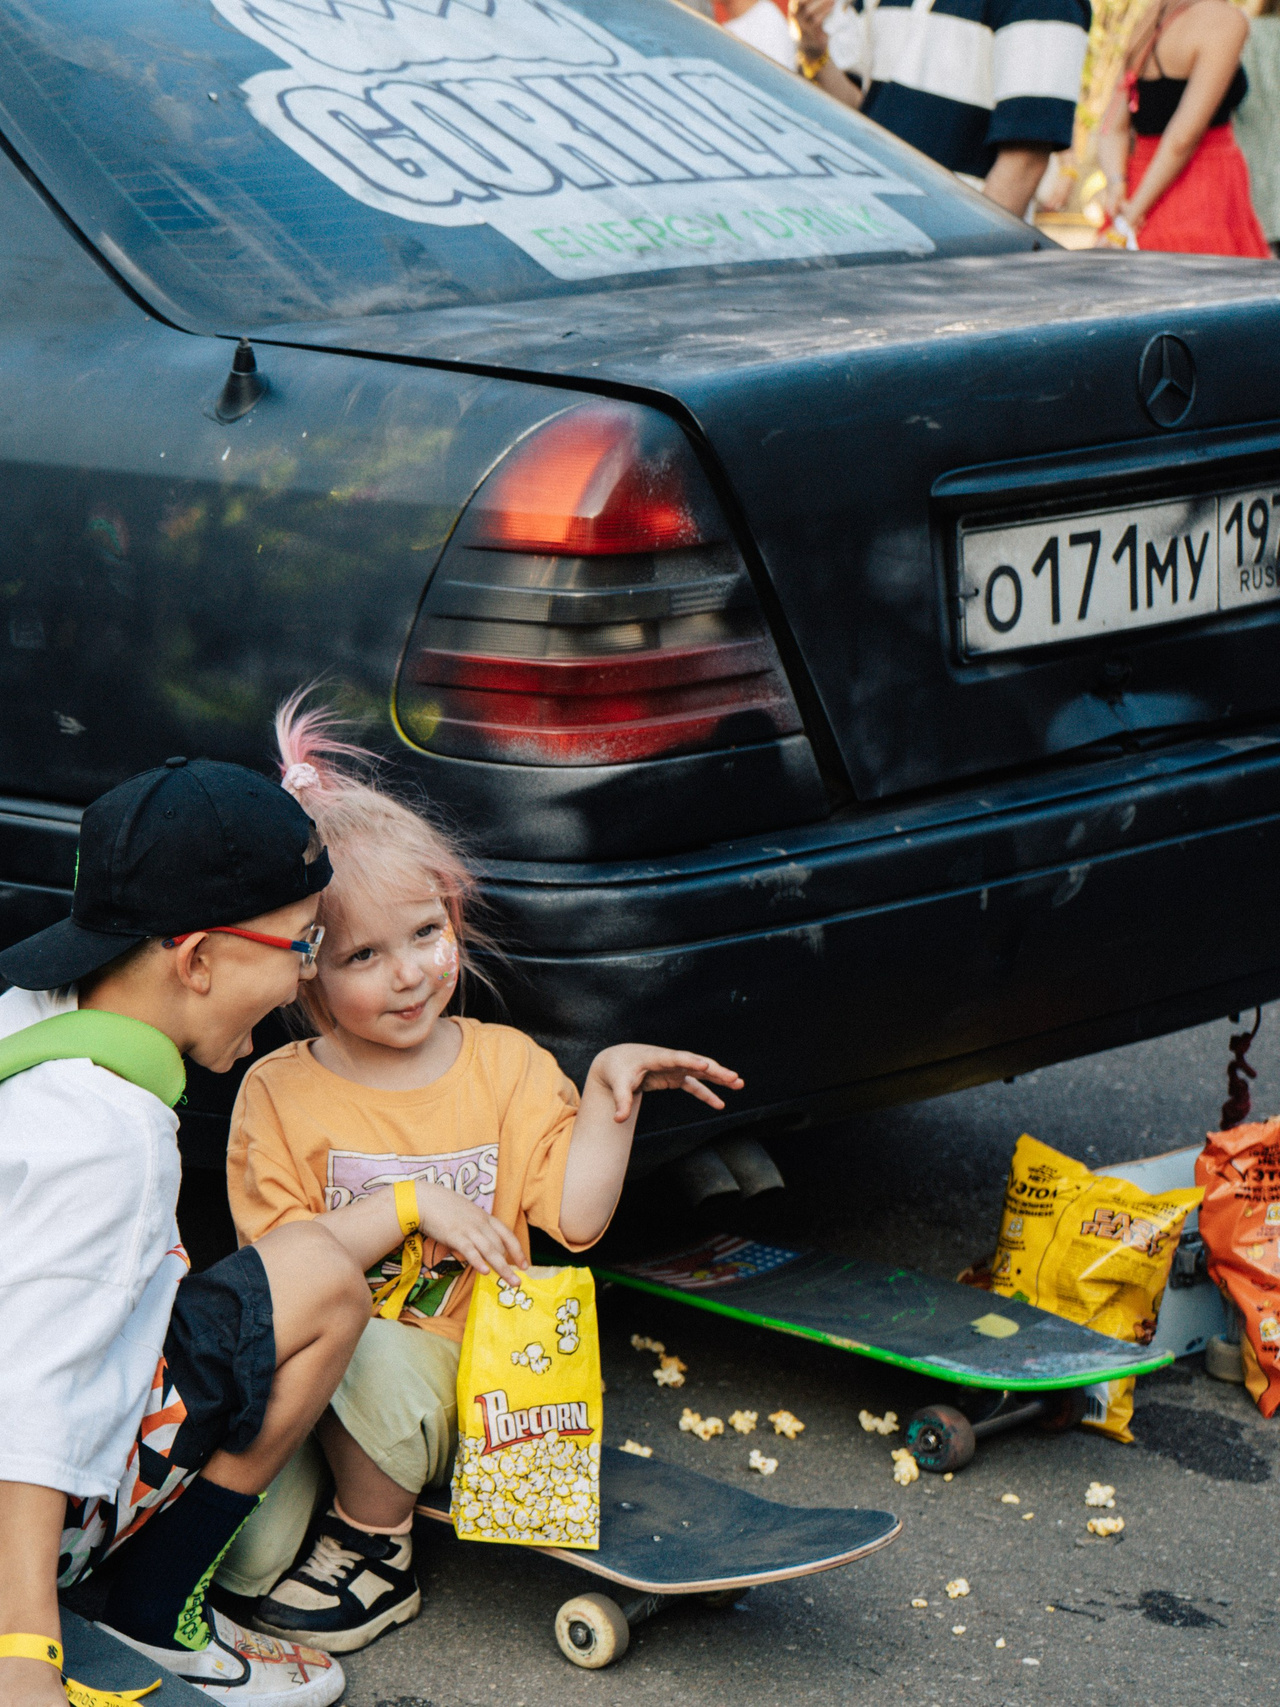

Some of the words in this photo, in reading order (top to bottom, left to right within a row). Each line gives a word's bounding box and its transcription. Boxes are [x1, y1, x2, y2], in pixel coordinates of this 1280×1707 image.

[279, 72, 885, 206] GORILLA
[531, 212, 742, 259] ENERGY
[741, 204, 897, 240] DRINK
[1240, 565, 1275, 592] RUS
[1080, 1221, 1164, 1258] PEASY
[1094, 1208, 1170, 1240] EASY
